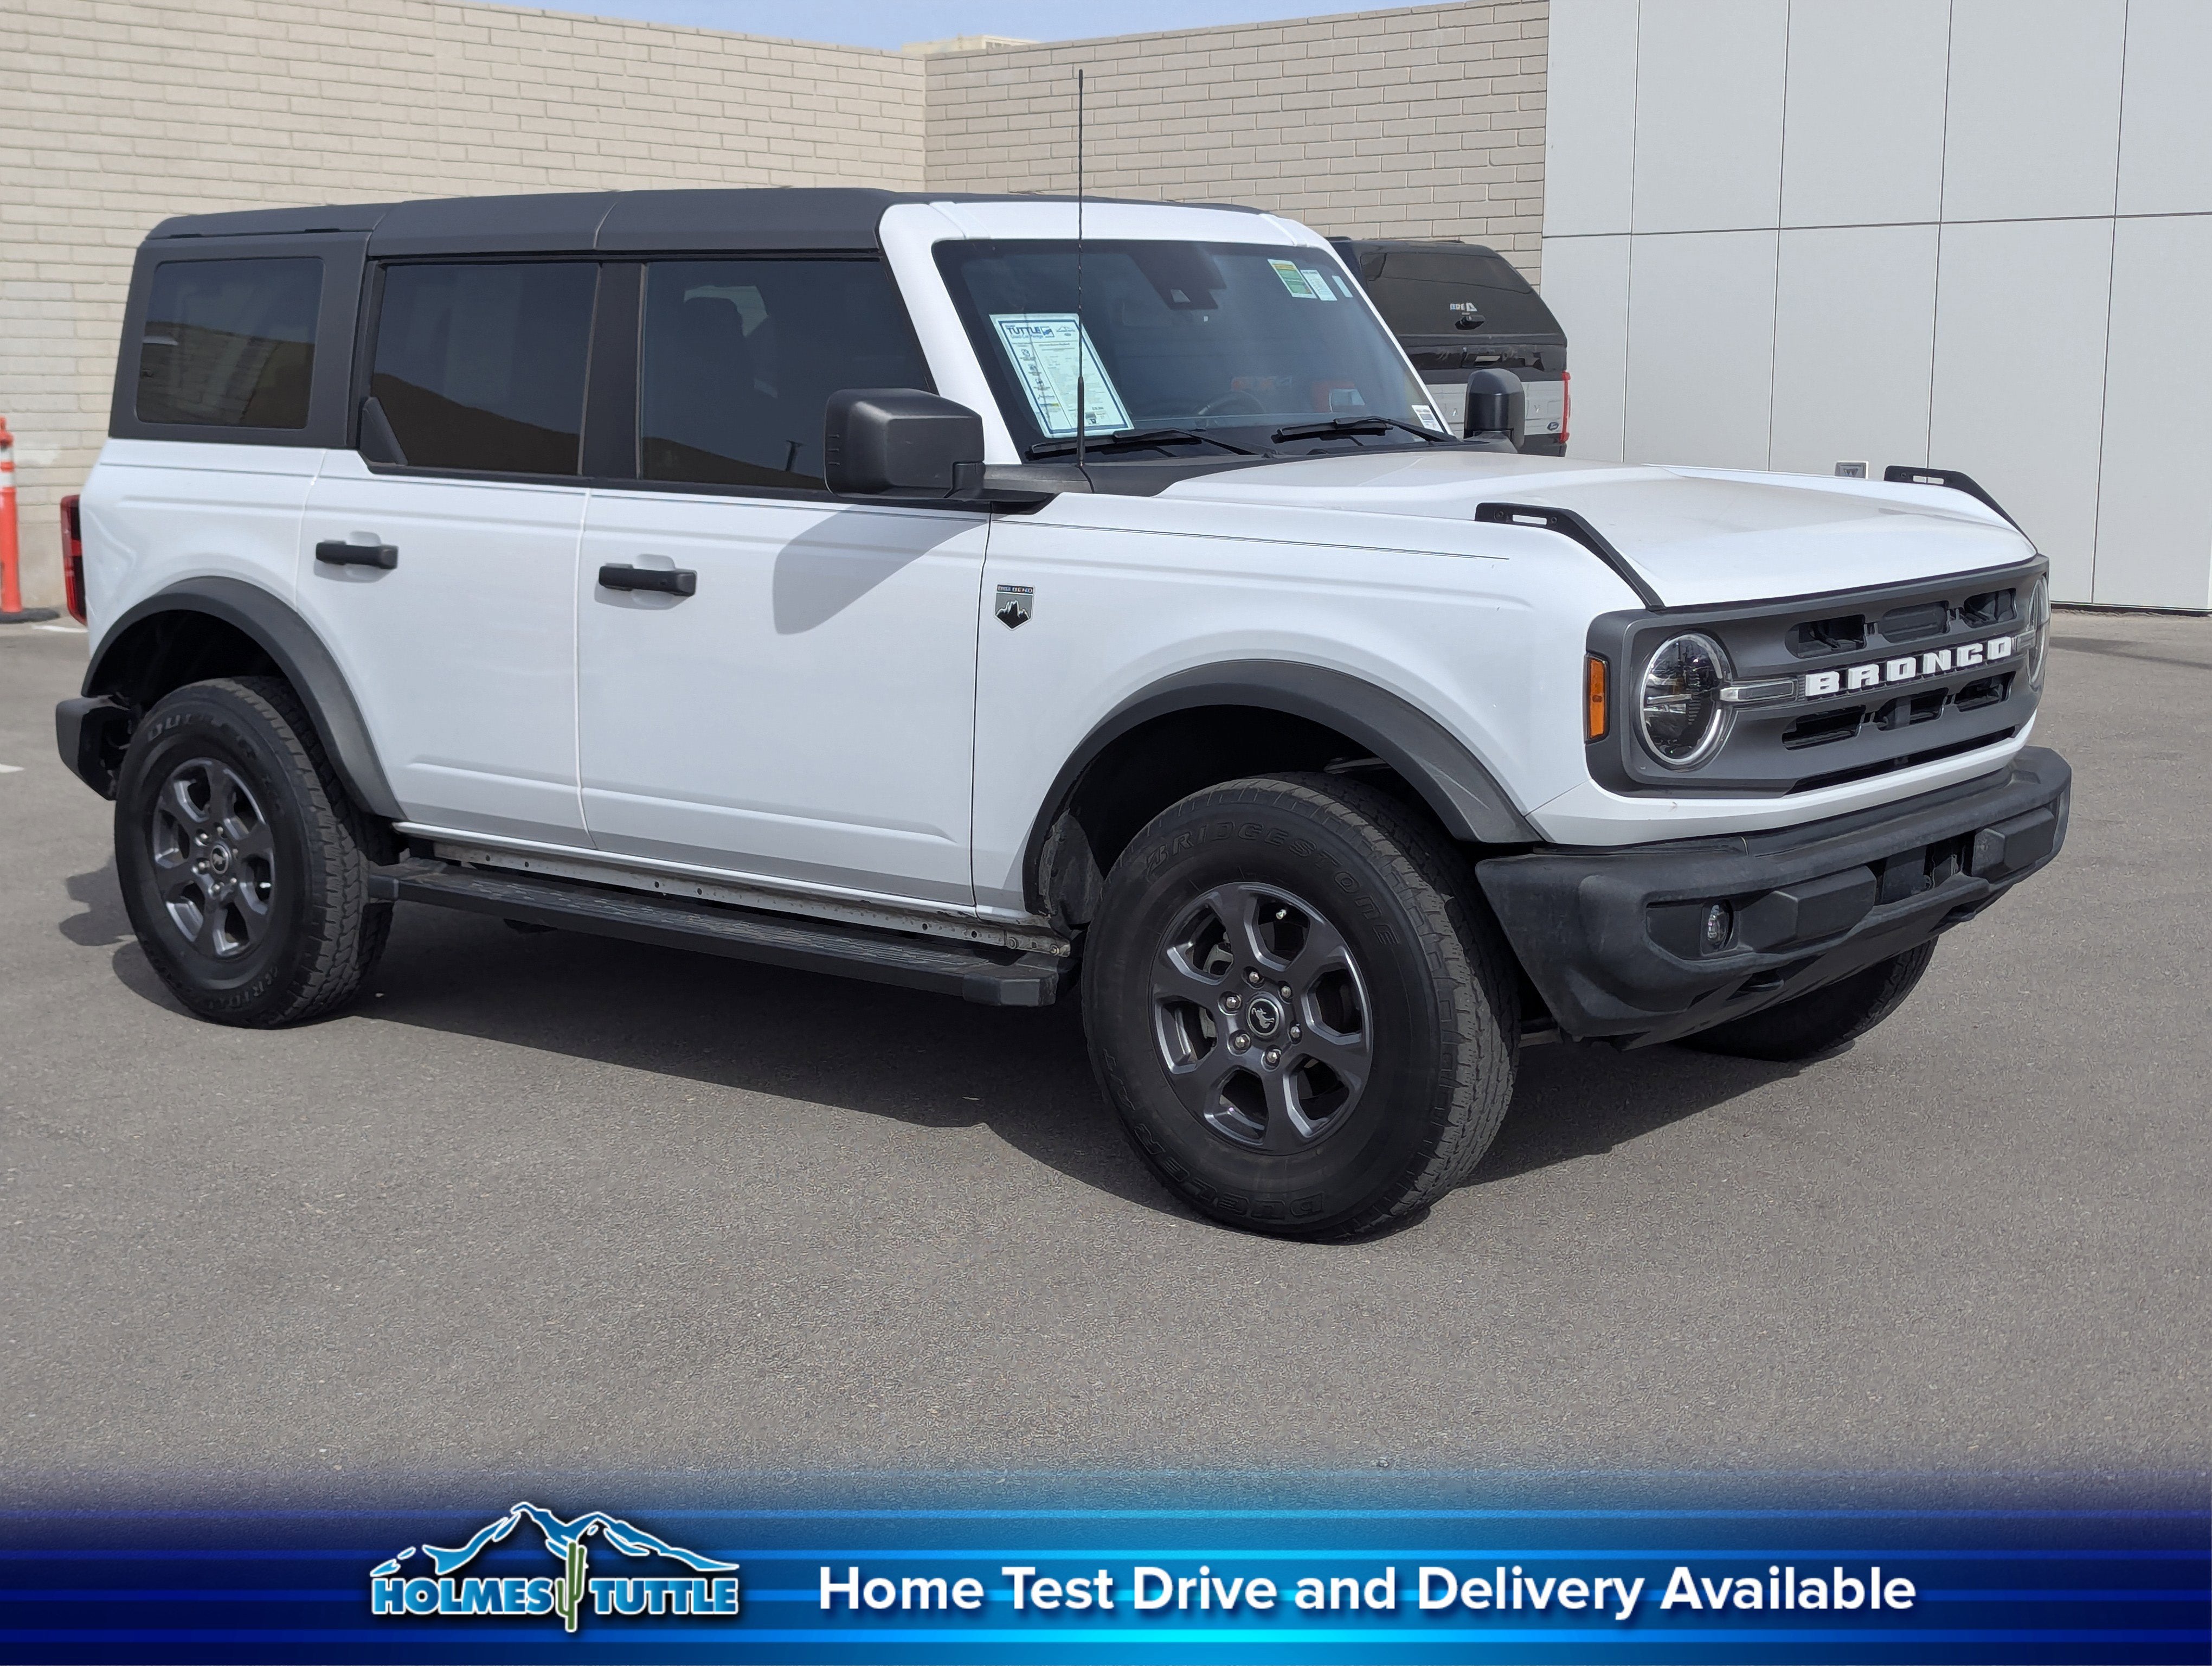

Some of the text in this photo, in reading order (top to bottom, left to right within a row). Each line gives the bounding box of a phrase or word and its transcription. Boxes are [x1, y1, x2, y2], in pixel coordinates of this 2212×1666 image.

[1006, 326, 1042, 335] TUTTLE
[1805, 637, 2011, 697] BRONCO
[1145, 821, 1401, 946] BRIDGESTONE
[1134, 1123, 1324, 1221] DUELER
